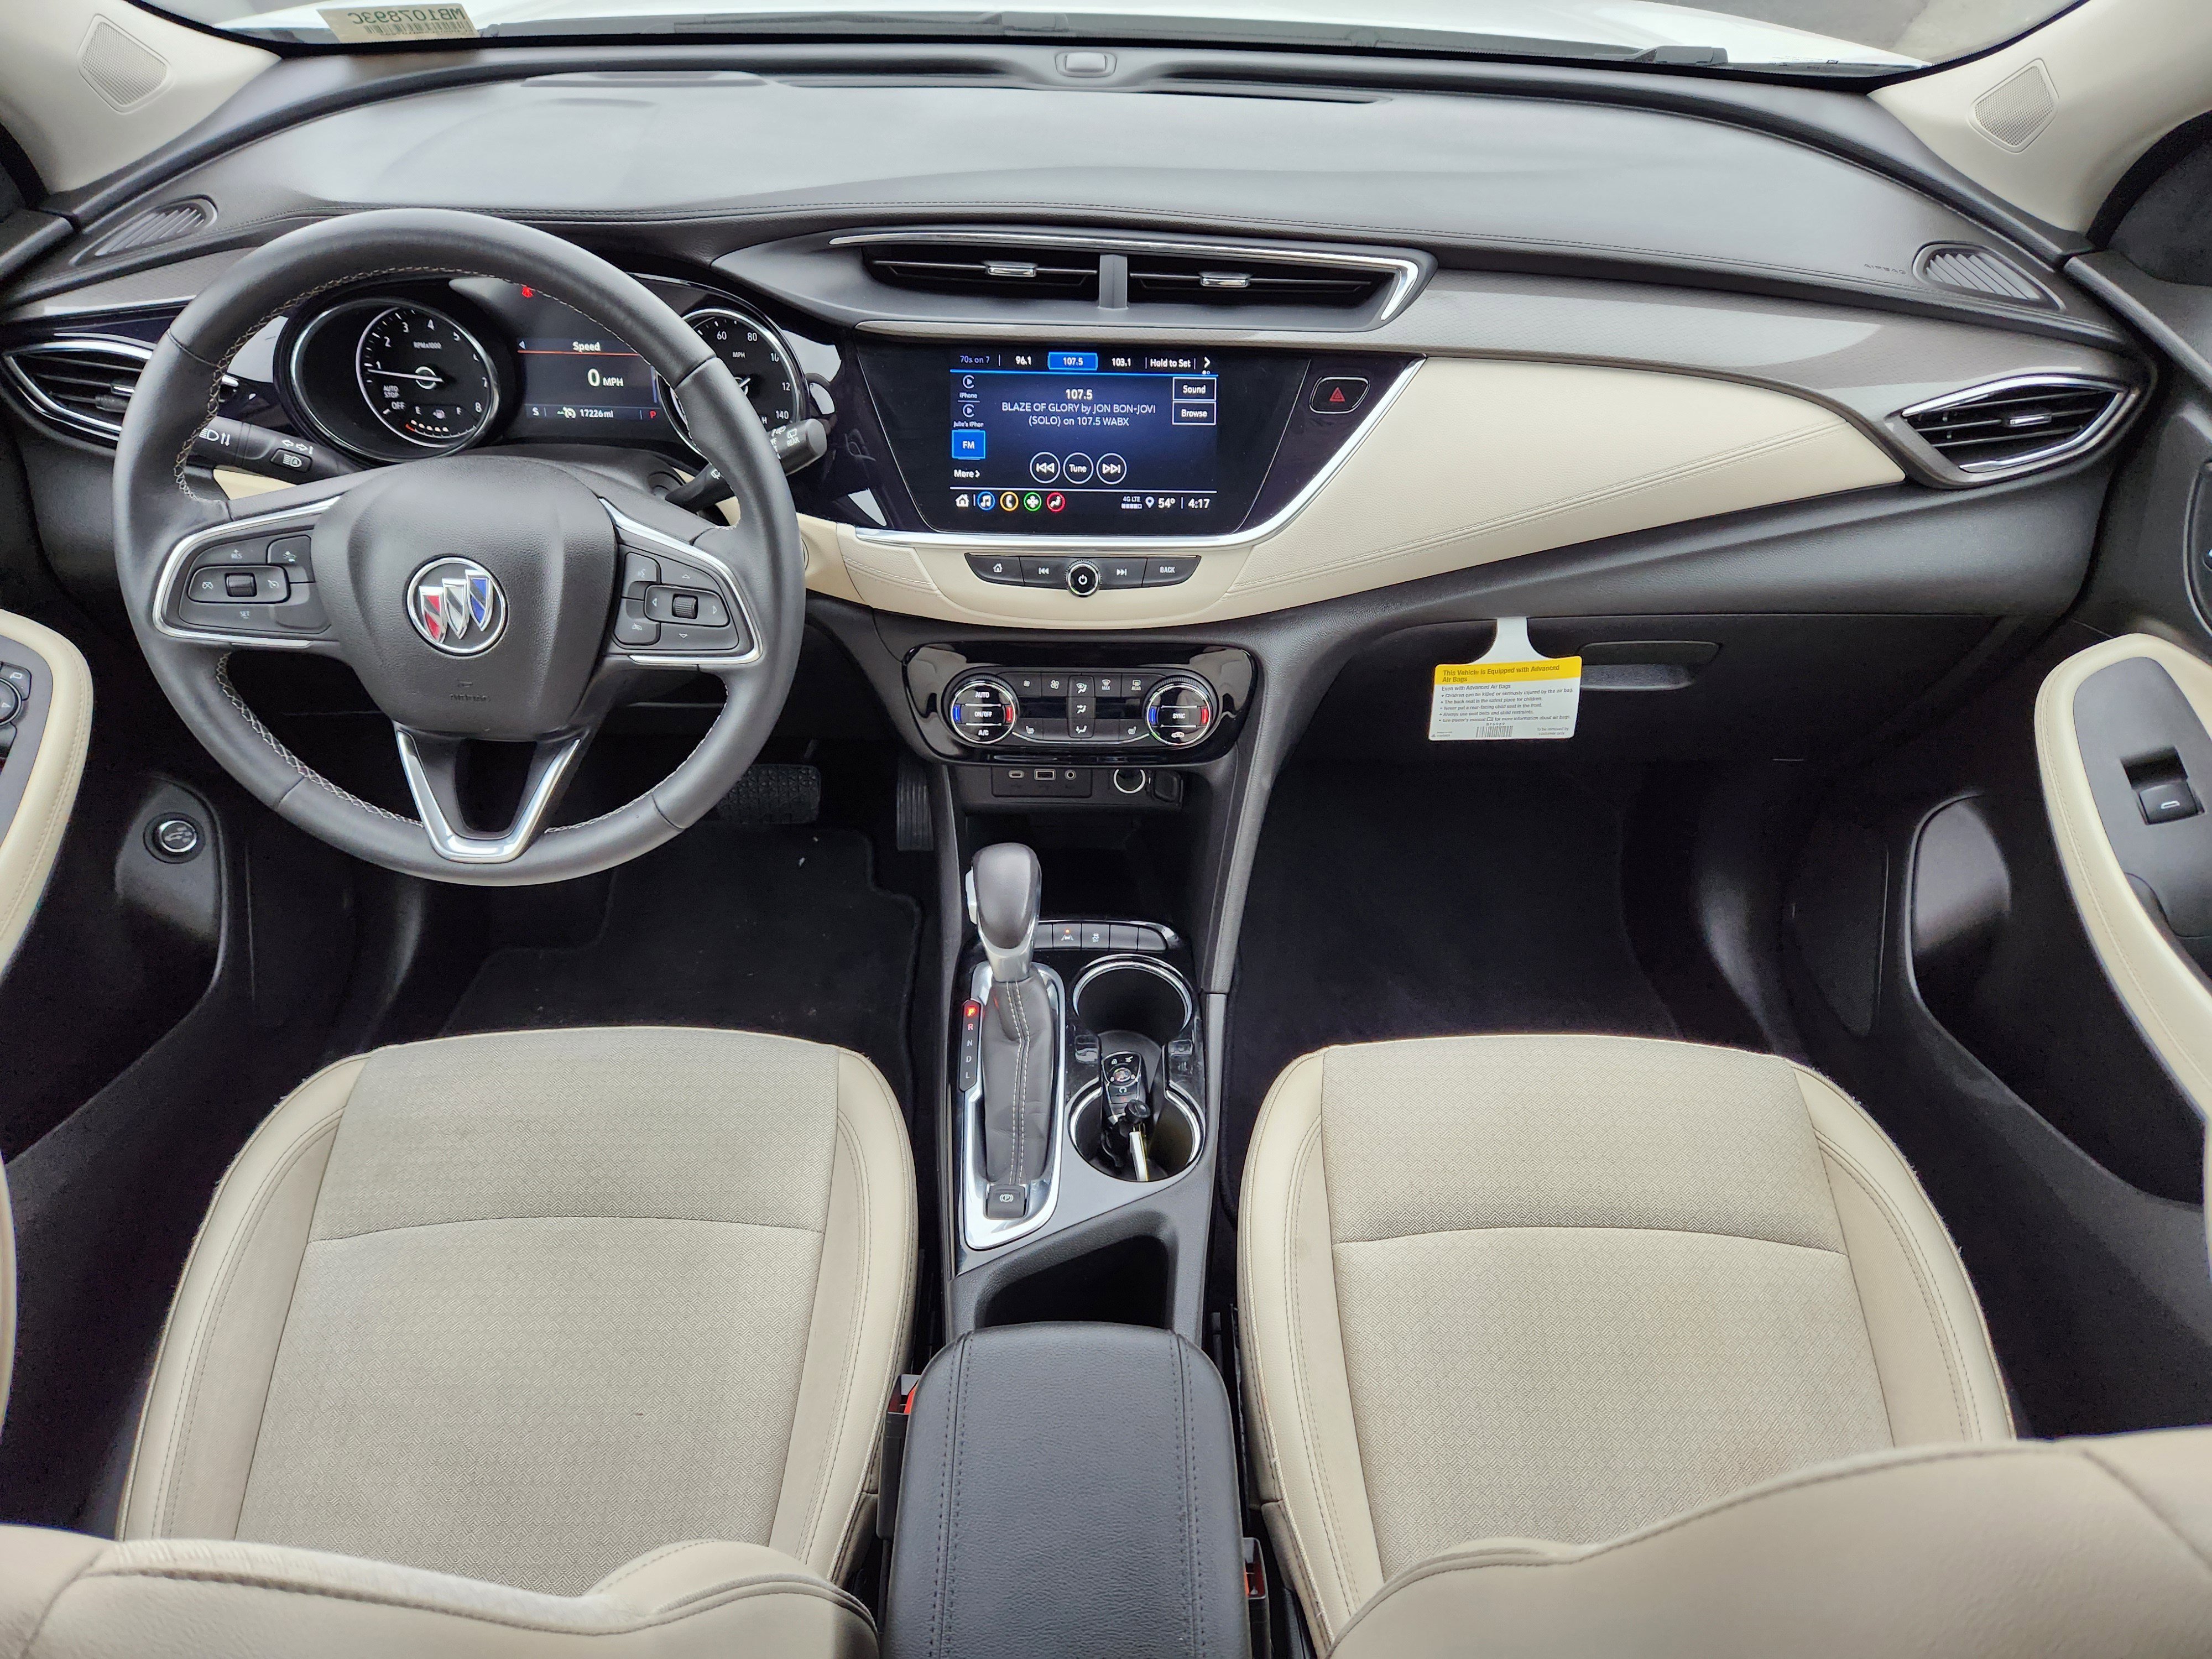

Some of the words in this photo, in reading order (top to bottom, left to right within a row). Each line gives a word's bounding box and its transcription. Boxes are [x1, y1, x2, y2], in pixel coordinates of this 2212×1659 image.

[402, 322, 409, 333] 3
[427, 319, 435, 331] 4
[717, 331, 727, 340] 60
[748, 332, 758, 342] 80
[384, 336, 392, 348] 2
[572, 341, 601, 352] Speed
[1015, 356, 1032, 365] 96.1
[1063, 357, 1083, 366] 107.5
[1112, 358, 1131, 367] 103.1
[1150, 358, 1168, 368] Hold
[1178, 359, 1191, 368] Set
[588, 368, 600, 387] 0
[603, 377, 624, 387] MPH
[1066, 389, 1093, 400] 107.5
[1183, 385, 1206, 394] Sound
[392, 401, 406, 410] OFF
[415, 406, 421, 415] E
[476, 402, 482, 413] 8
[1001, 402, 1031, 411] BLAZE
[1033, 403, 1047, 412] OF
[1048, 403, 1079, 413] GLORY
[1081, 404, 1092, 414] by
[1093, 404, 1110, 414] JON
[1113, 404, 1156, 415] BON-JOVI
[650, 410, 656, 419] P
[776, 410, 790, 419] 140
[1181, 409, 1208, 418] Browse
[1029, 415, 1061, 427] (SOLO)
[1077, 417, 1100, 426] 107.5
[1102, 418, 1129, 426] WABX
[787, 437, 800, 447] REAR
[962, 441, 975, 449] FM
[1069, 463, 1087, 472] Tune
[953, 469, 974, 478] More
[1188, 498, 1210, 508] 4:17
[968, 1006, 975, 1016] P
